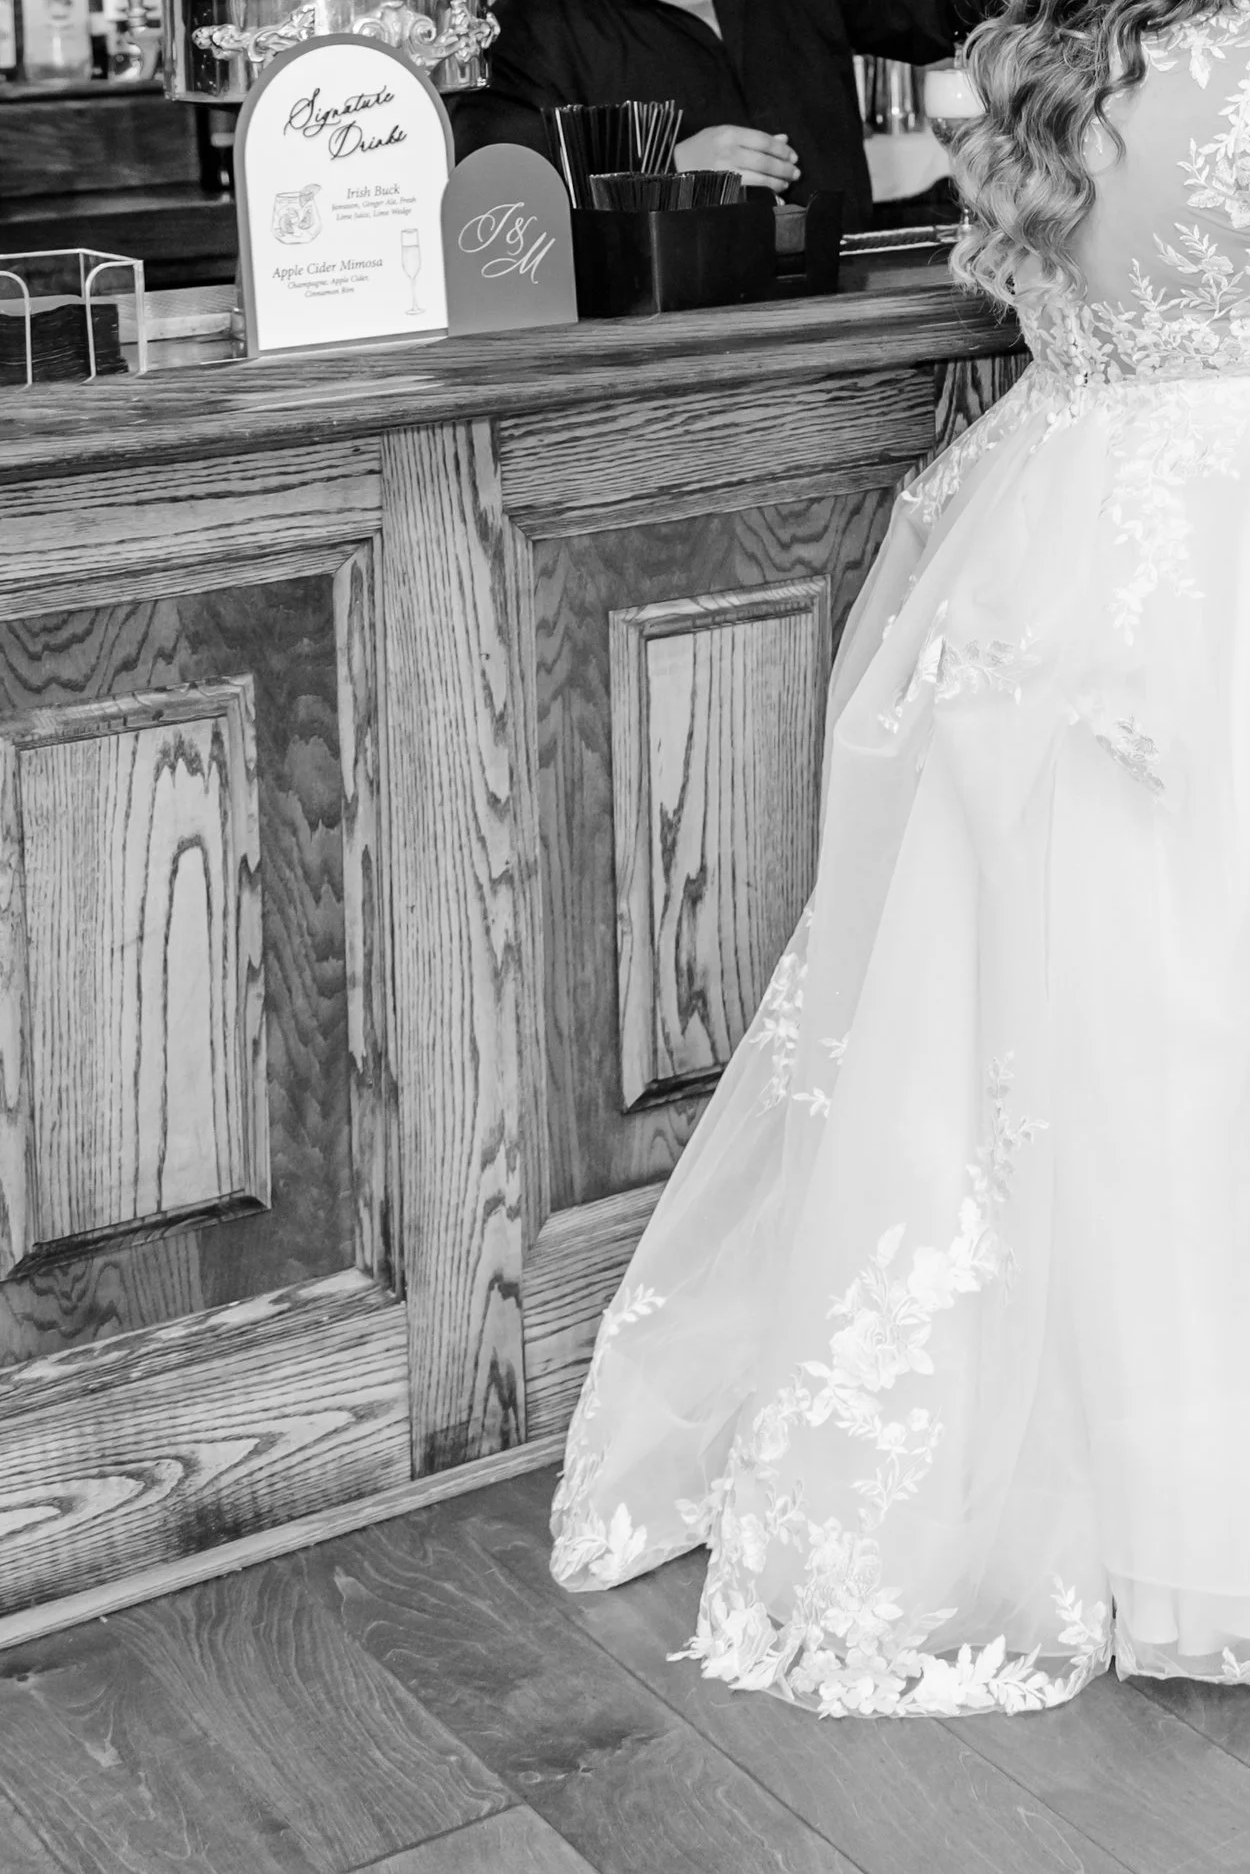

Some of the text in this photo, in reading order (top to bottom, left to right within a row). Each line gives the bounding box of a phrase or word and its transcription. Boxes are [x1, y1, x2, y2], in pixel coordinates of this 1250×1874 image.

[283, 85, 395, 138] Signature
[328, 120, 407, 160] Drinks
[346, 182, 400, 199] Irish Buck
[272, 258, 383, 281] Apple Cider Mimosa
[481, 232, 556, 284] M
